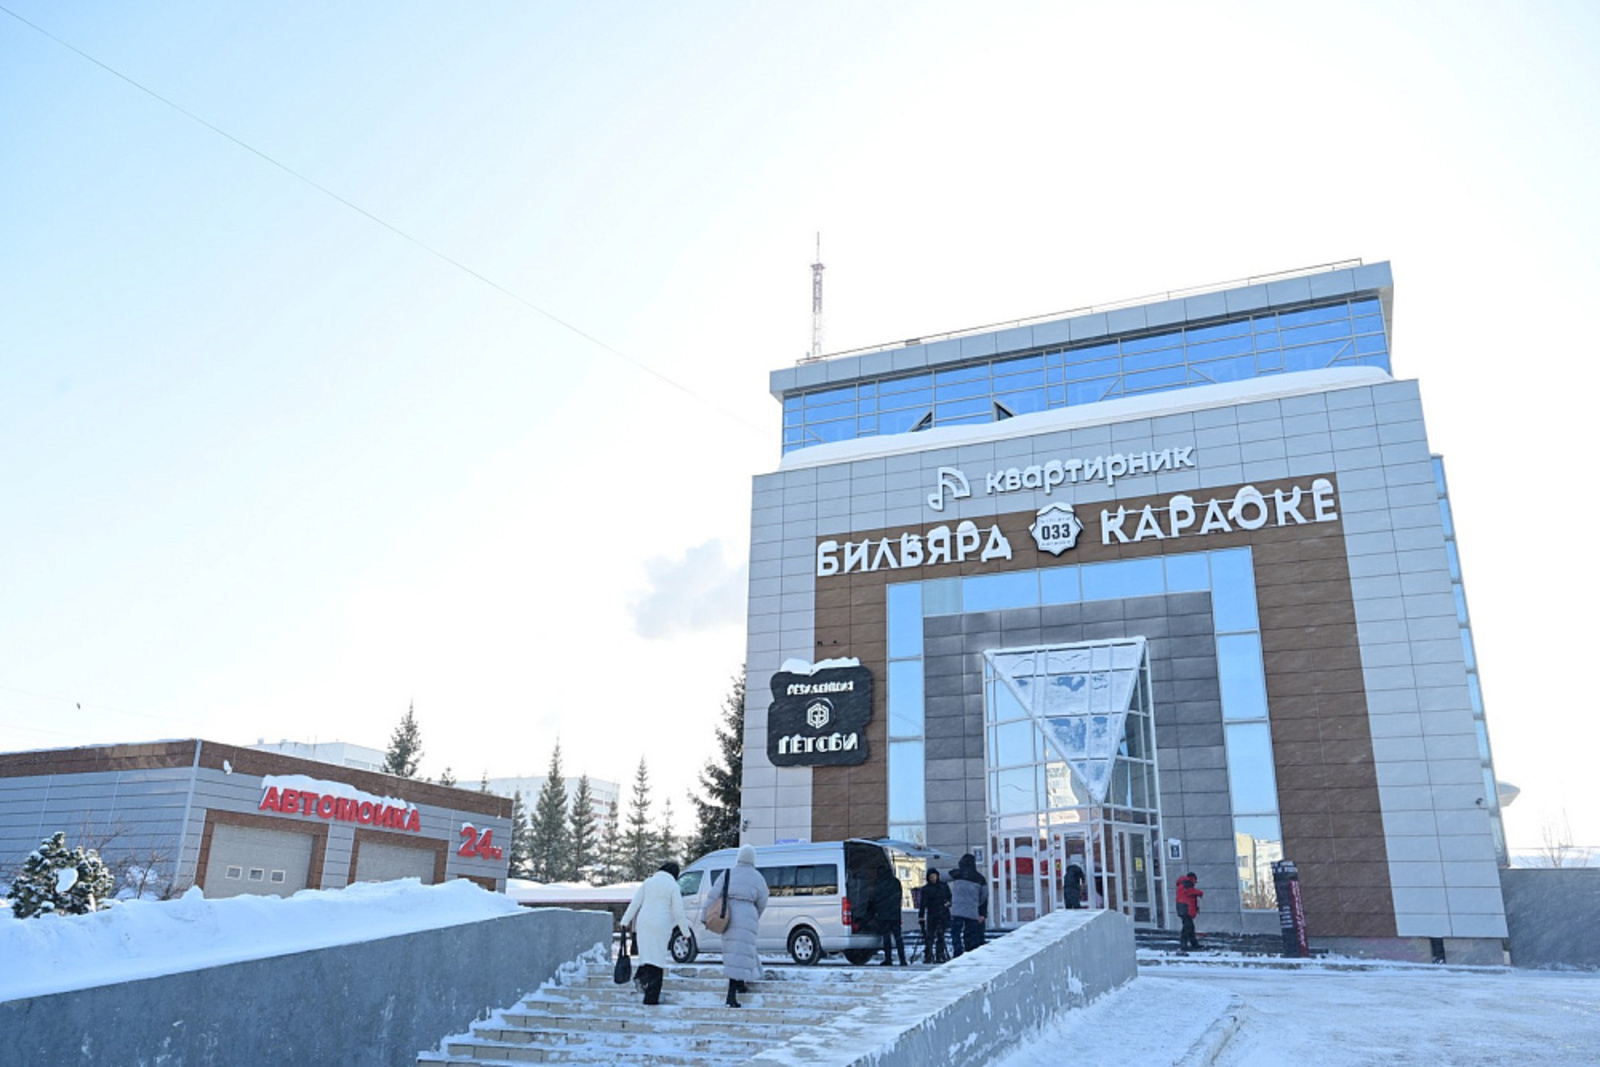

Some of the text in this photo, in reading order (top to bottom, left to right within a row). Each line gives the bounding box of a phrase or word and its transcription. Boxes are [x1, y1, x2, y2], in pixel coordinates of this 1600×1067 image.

[986, 446, 1196, 494] квартирник
[1041, 523, 1071, 540] 033
[1100, 478, 1339, 546] КАРАОКЕ
[817, 520, 1012, 577] БИЛЬЯРД
[778, 732, 859, 755] ГЕТСБИ
